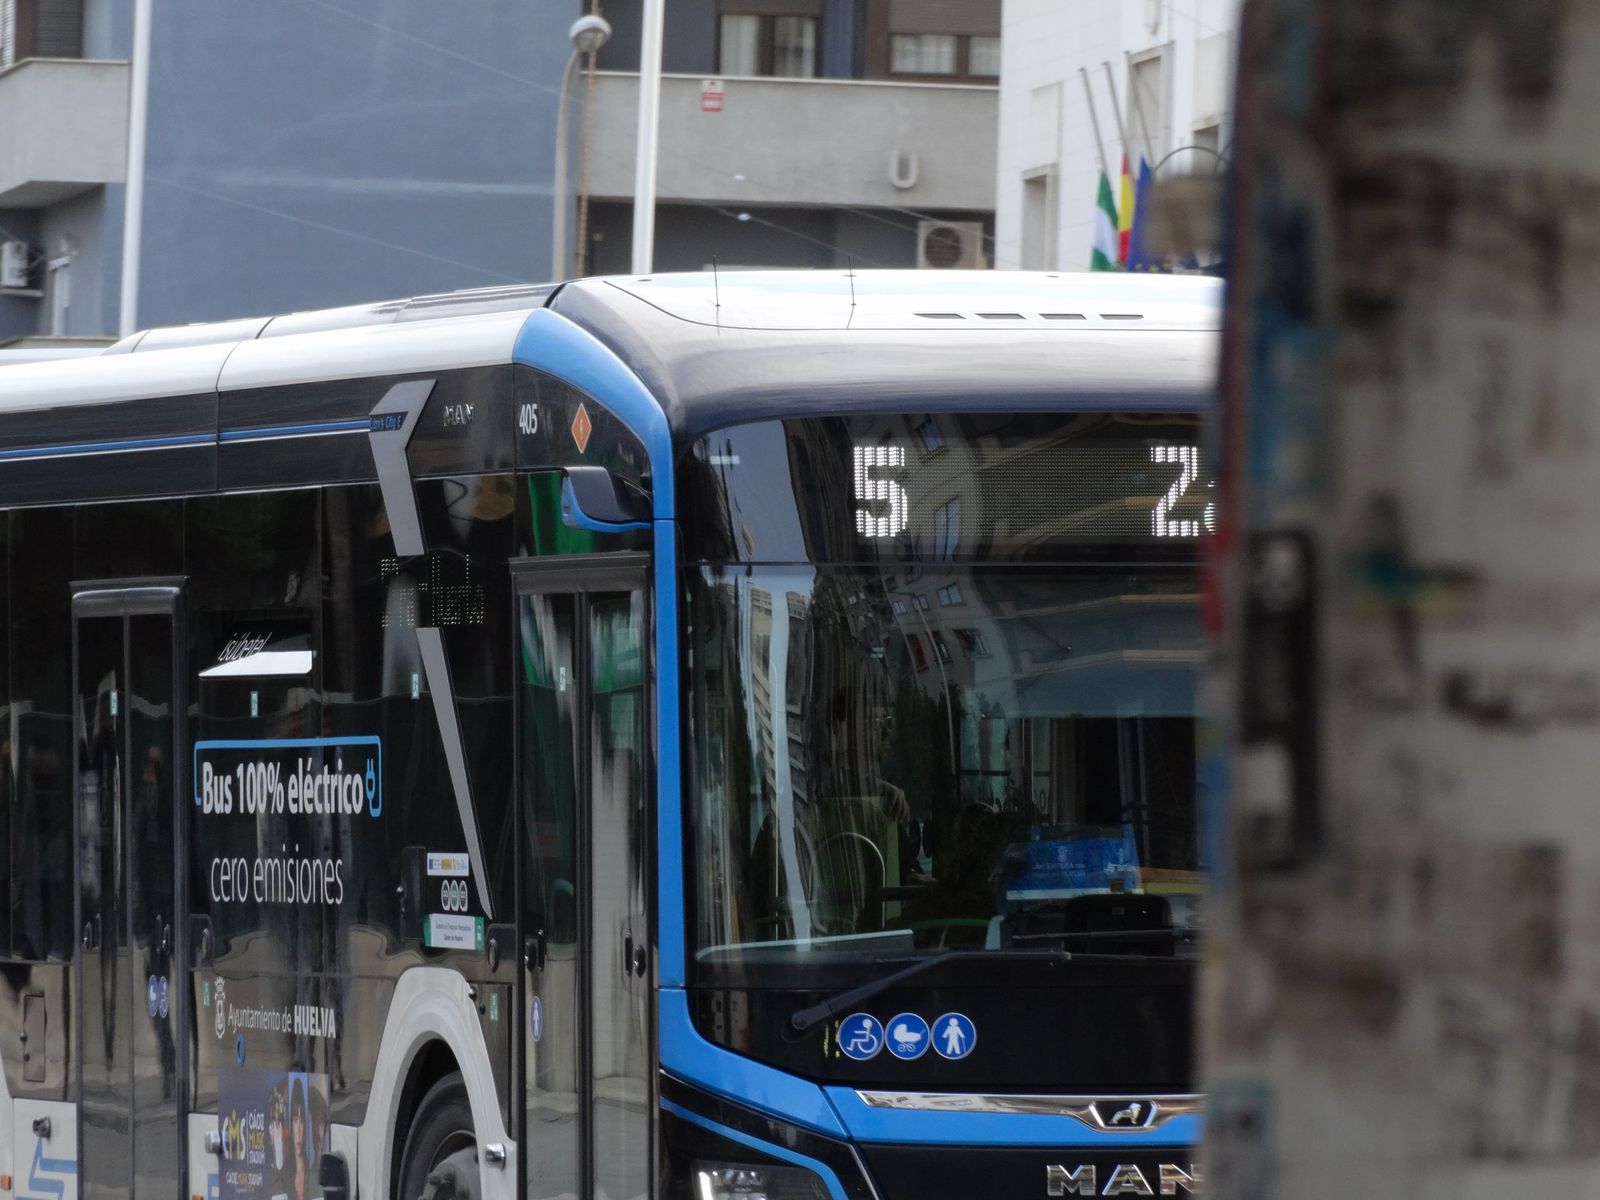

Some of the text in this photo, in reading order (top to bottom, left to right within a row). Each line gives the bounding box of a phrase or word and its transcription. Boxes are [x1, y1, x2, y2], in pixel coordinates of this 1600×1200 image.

[519, 403, 538, 434] 405
[853, 446, 908, 537] 5
[202, 757, 364, 814] Bus 100% eléctrico
[211, 843, 344, 905] cero emisiones
[228, 1003, 337, 1039] Ayuntamiento de HUELVA
[1046, 1164, 1204, 1196] MAN
